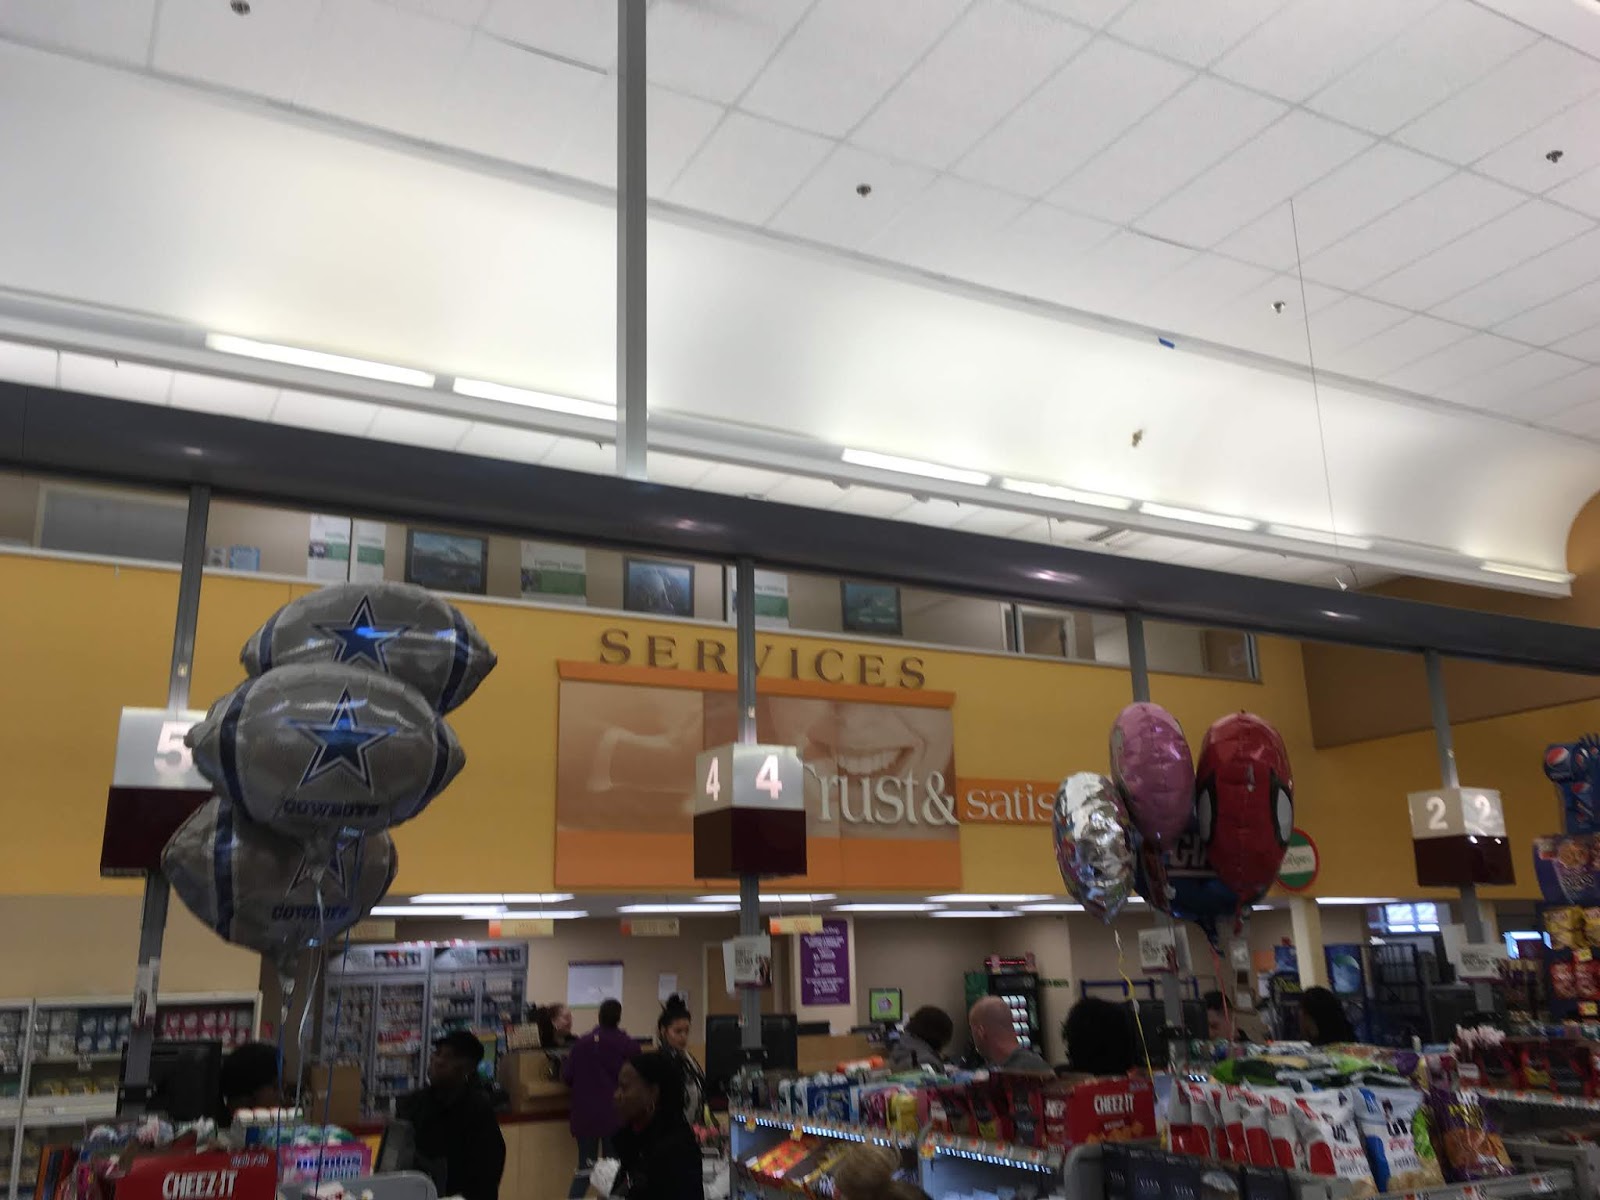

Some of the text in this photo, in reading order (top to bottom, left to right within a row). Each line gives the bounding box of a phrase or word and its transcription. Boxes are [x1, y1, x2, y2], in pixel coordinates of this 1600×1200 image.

[599, 628, 927, 690] SERVICES
[154, 721, 196, 775] 5
[705, 756, 721, 801] 4
[755, 754, 783, 800] 4
[1426, 796, 1449, 830] 2
[1475, 794, 1493, 827] 2
